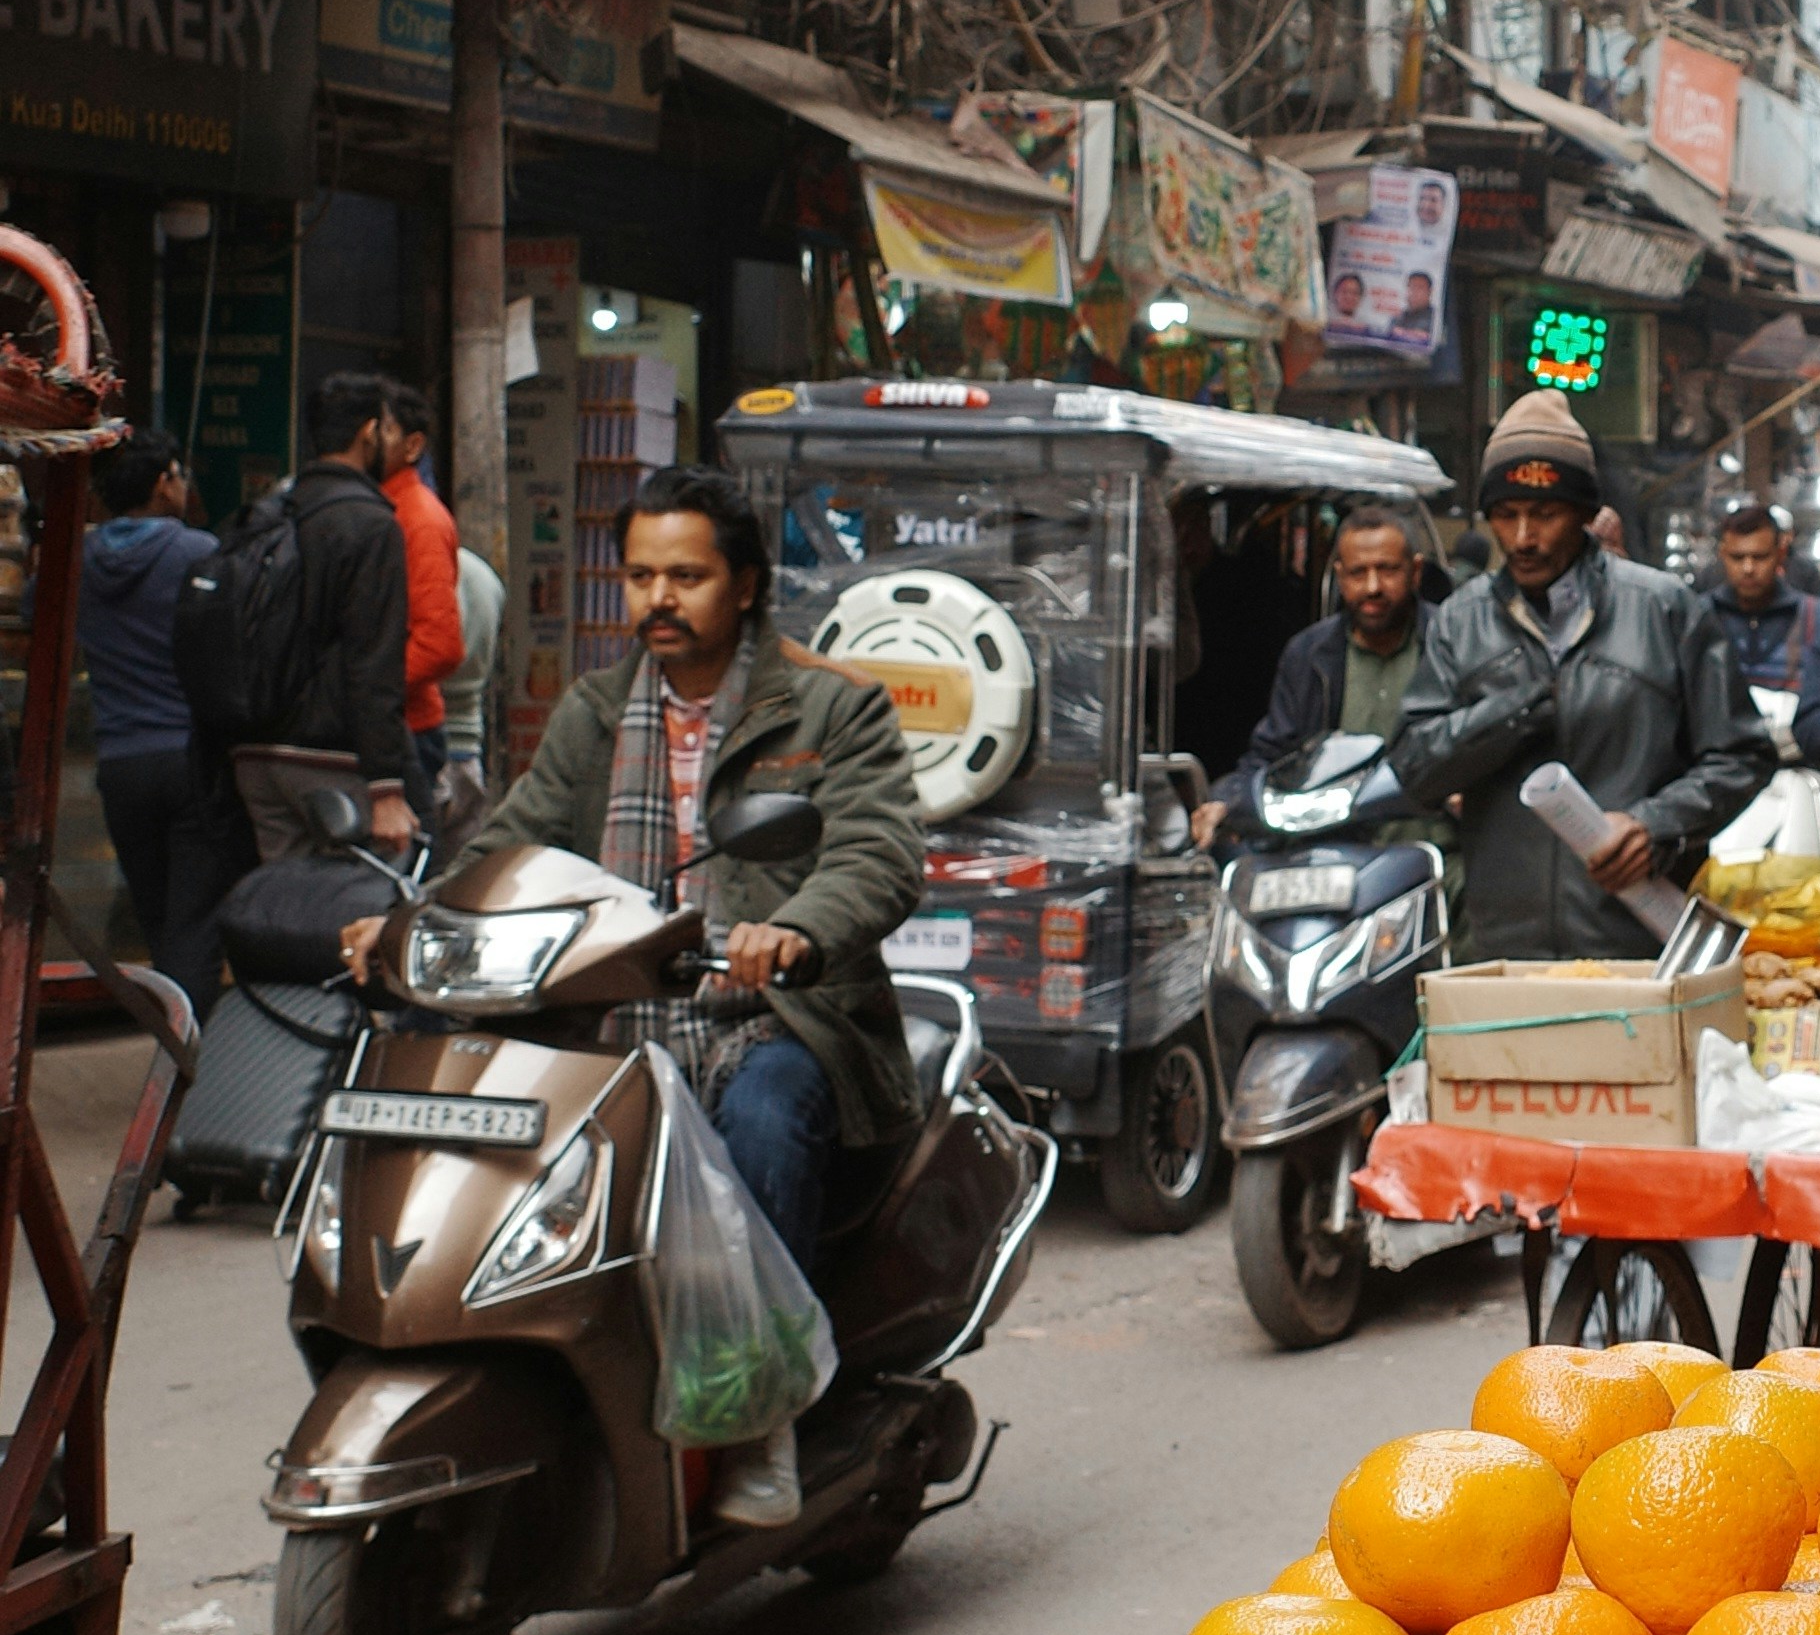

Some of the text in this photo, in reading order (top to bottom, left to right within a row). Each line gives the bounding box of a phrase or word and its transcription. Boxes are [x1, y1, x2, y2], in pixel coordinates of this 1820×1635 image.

[72, 96, 136, 140] Delhi
[146, 111, 233, 156] 110006
[894, 512, 979, 545] Yatri
[889, 682, 938, 709] atri
